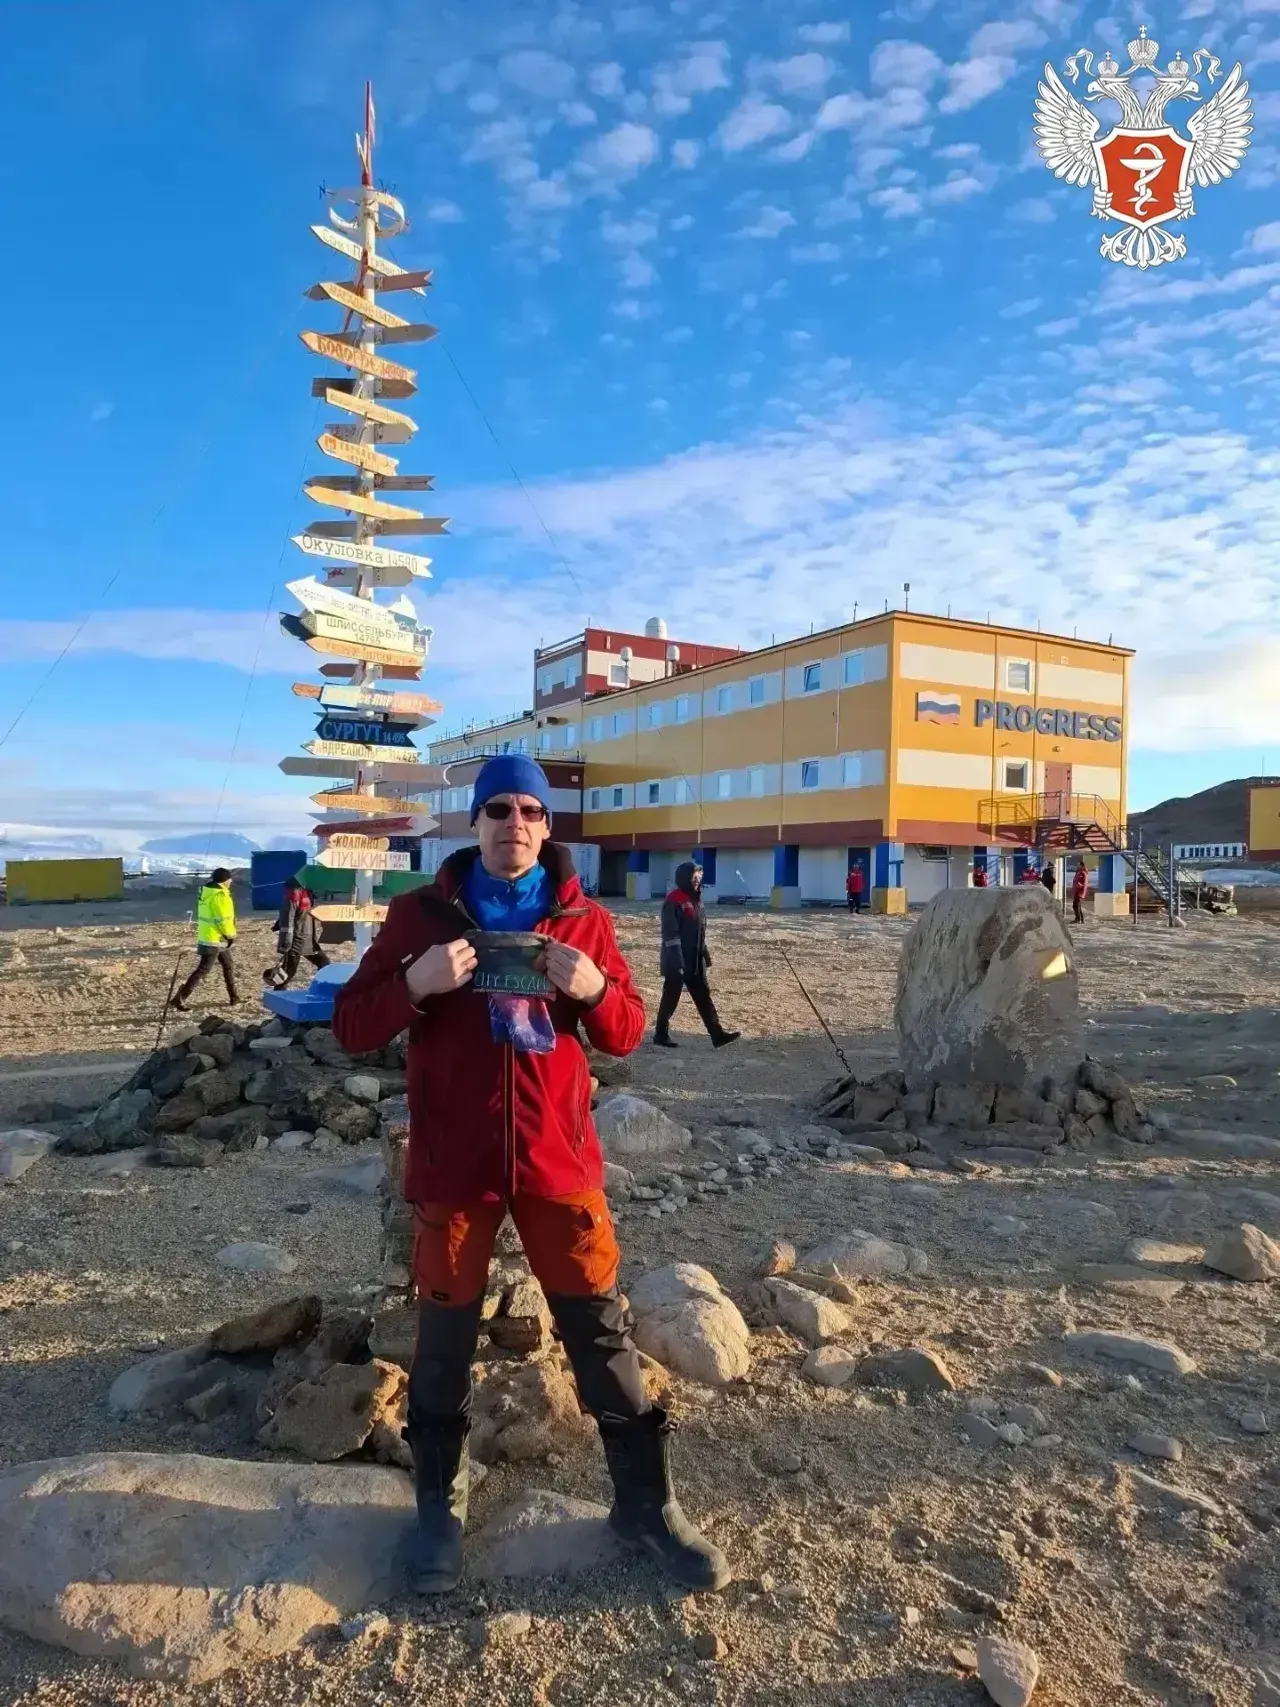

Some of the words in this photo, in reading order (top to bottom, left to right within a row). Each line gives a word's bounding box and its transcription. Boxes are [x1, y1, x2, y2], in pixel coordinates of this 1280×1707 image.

[302, 534, 384, 565] Окуловка
[326, 617, 409, 642] ШЛИССЕЛЬБУРГ
[322, 720, 383, 743] СУРГУТ
[974, 698, 1122, 742] PROGRESS
[335, 835, 379, 850] КОЛПИНО
[331, 850, 388, 869] ПУШКИН
